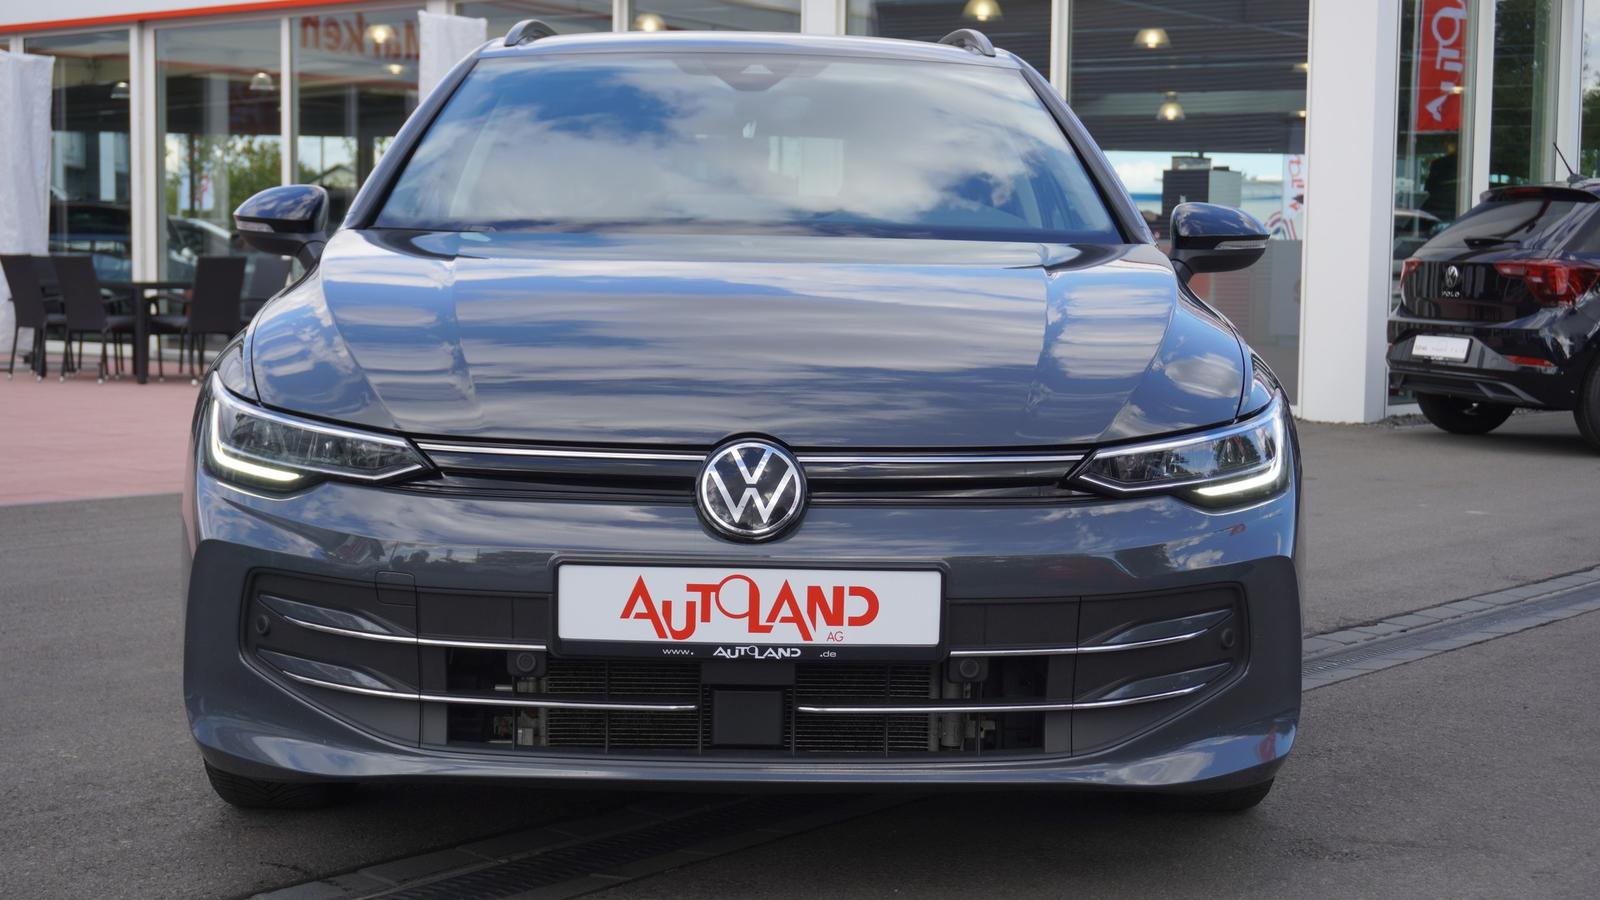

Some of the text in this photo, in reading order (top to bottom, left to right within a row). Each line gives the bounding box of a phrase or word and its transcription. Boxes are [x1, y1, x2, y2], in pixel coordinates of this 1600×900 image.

[702, 442, 800, 532] VW
[621, 575, 879, 640] AUTOLAND
[826, 631, 844, 642] AG
